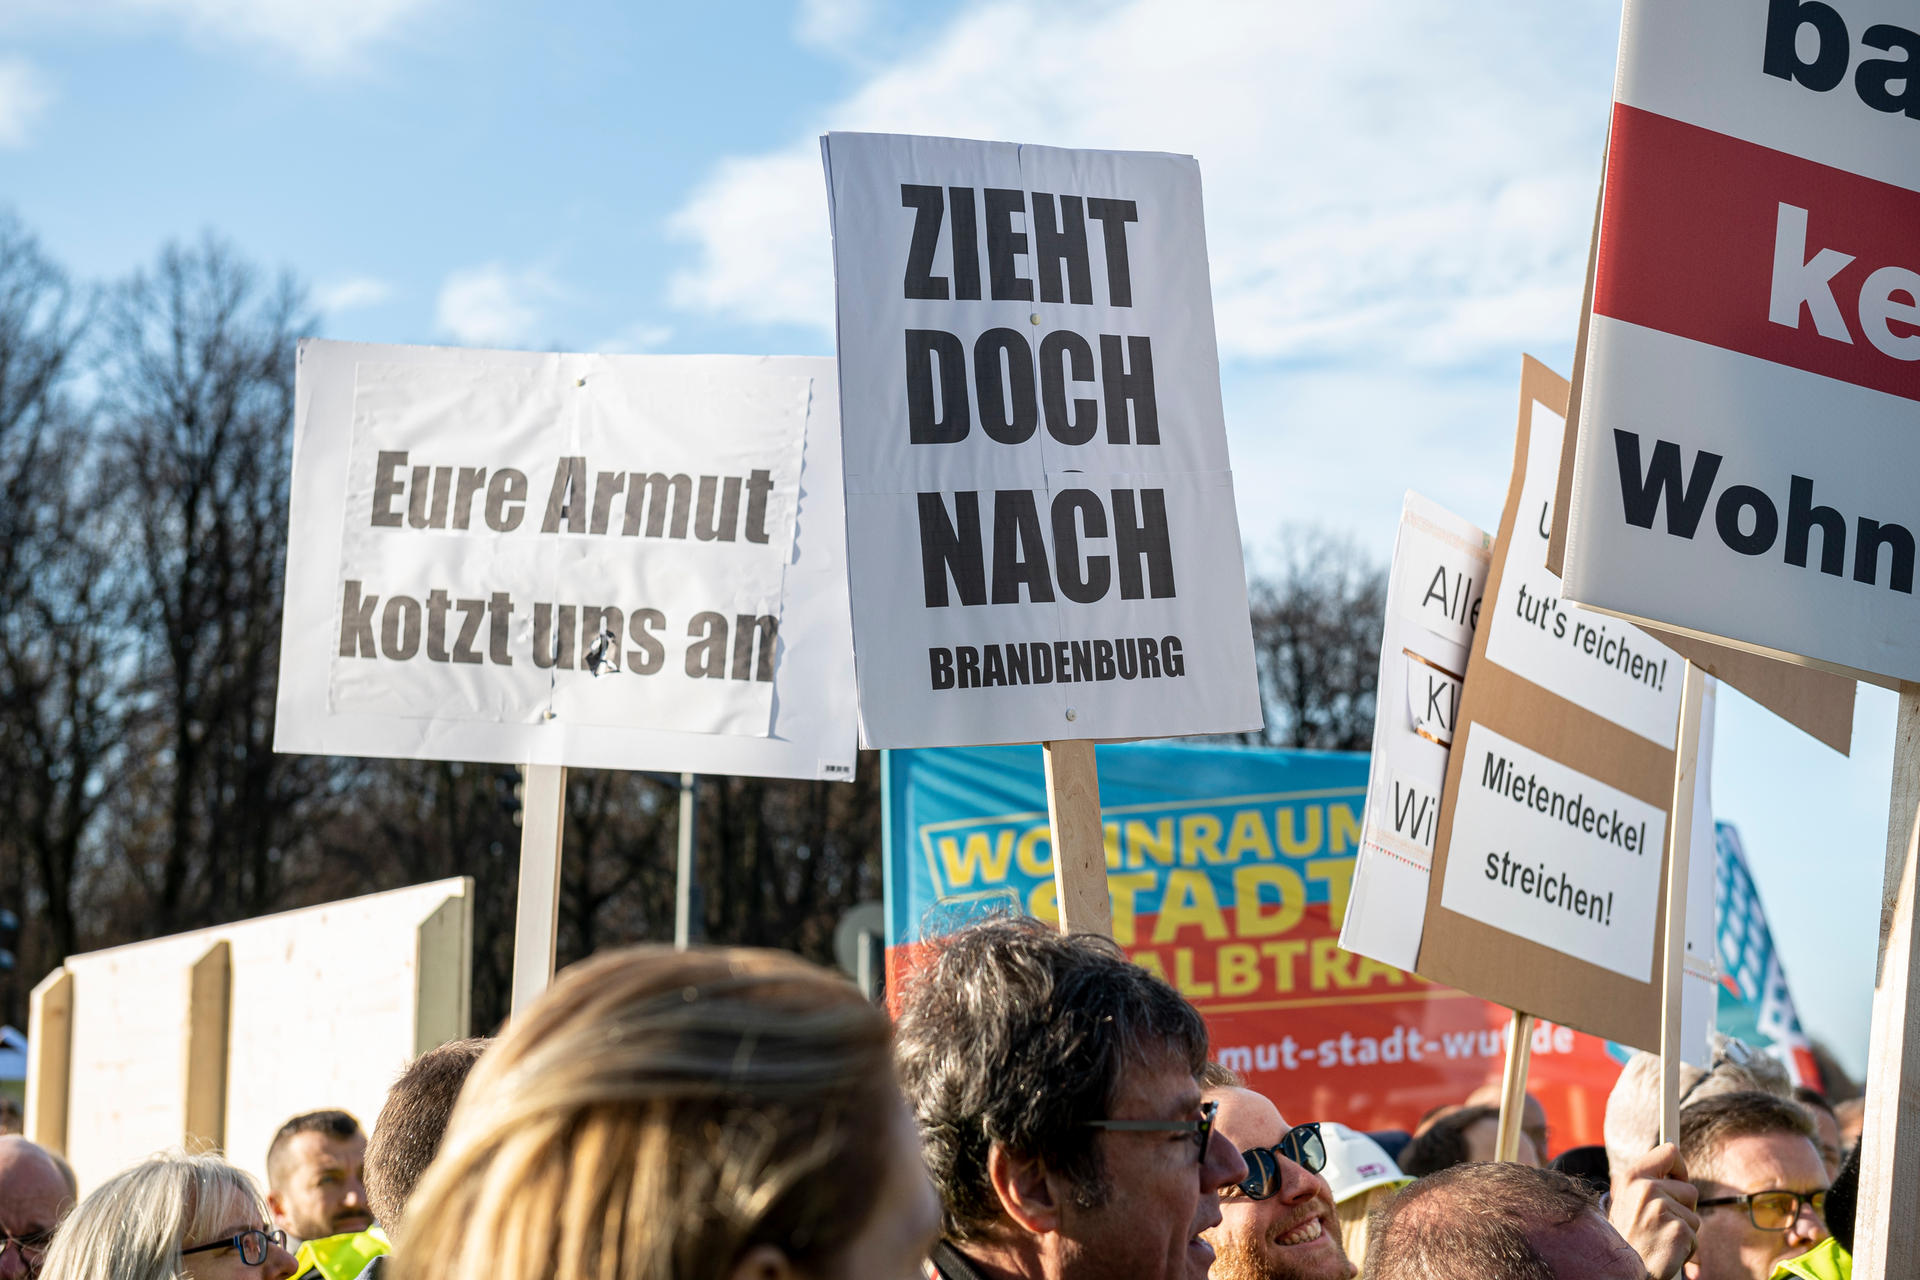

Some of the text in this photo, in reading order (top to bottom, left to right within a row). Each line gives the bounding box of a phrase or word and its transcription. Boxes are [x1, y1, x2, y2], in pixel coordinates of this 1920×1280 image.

[900, 183, 1138, 308] ZIEHT
[1768, 201, 1920, 361] ke
[904, 327, 1161, 446] DOCH
[370, 450, 774, 544] Eure Armut
[917, 488, 1176, 608] NACH
[1613, 428, 1915, 595] Wohn
[338, 580, 780, 682] kotzt uns an
[929, 635, 1186, 690] BRANDENBURG
[1516, 583, 1667, 692] tut's reichen!
[1394, 780, 1436, 847] Wi
[1482, 751, 1646, 855] Mietendeckel
[1485, 850, 1614, 926] streichen!
[1130, 936, 1430, 998] LBTRA
[1218, 1019, 1574, 1072] mut-stadt-wude
